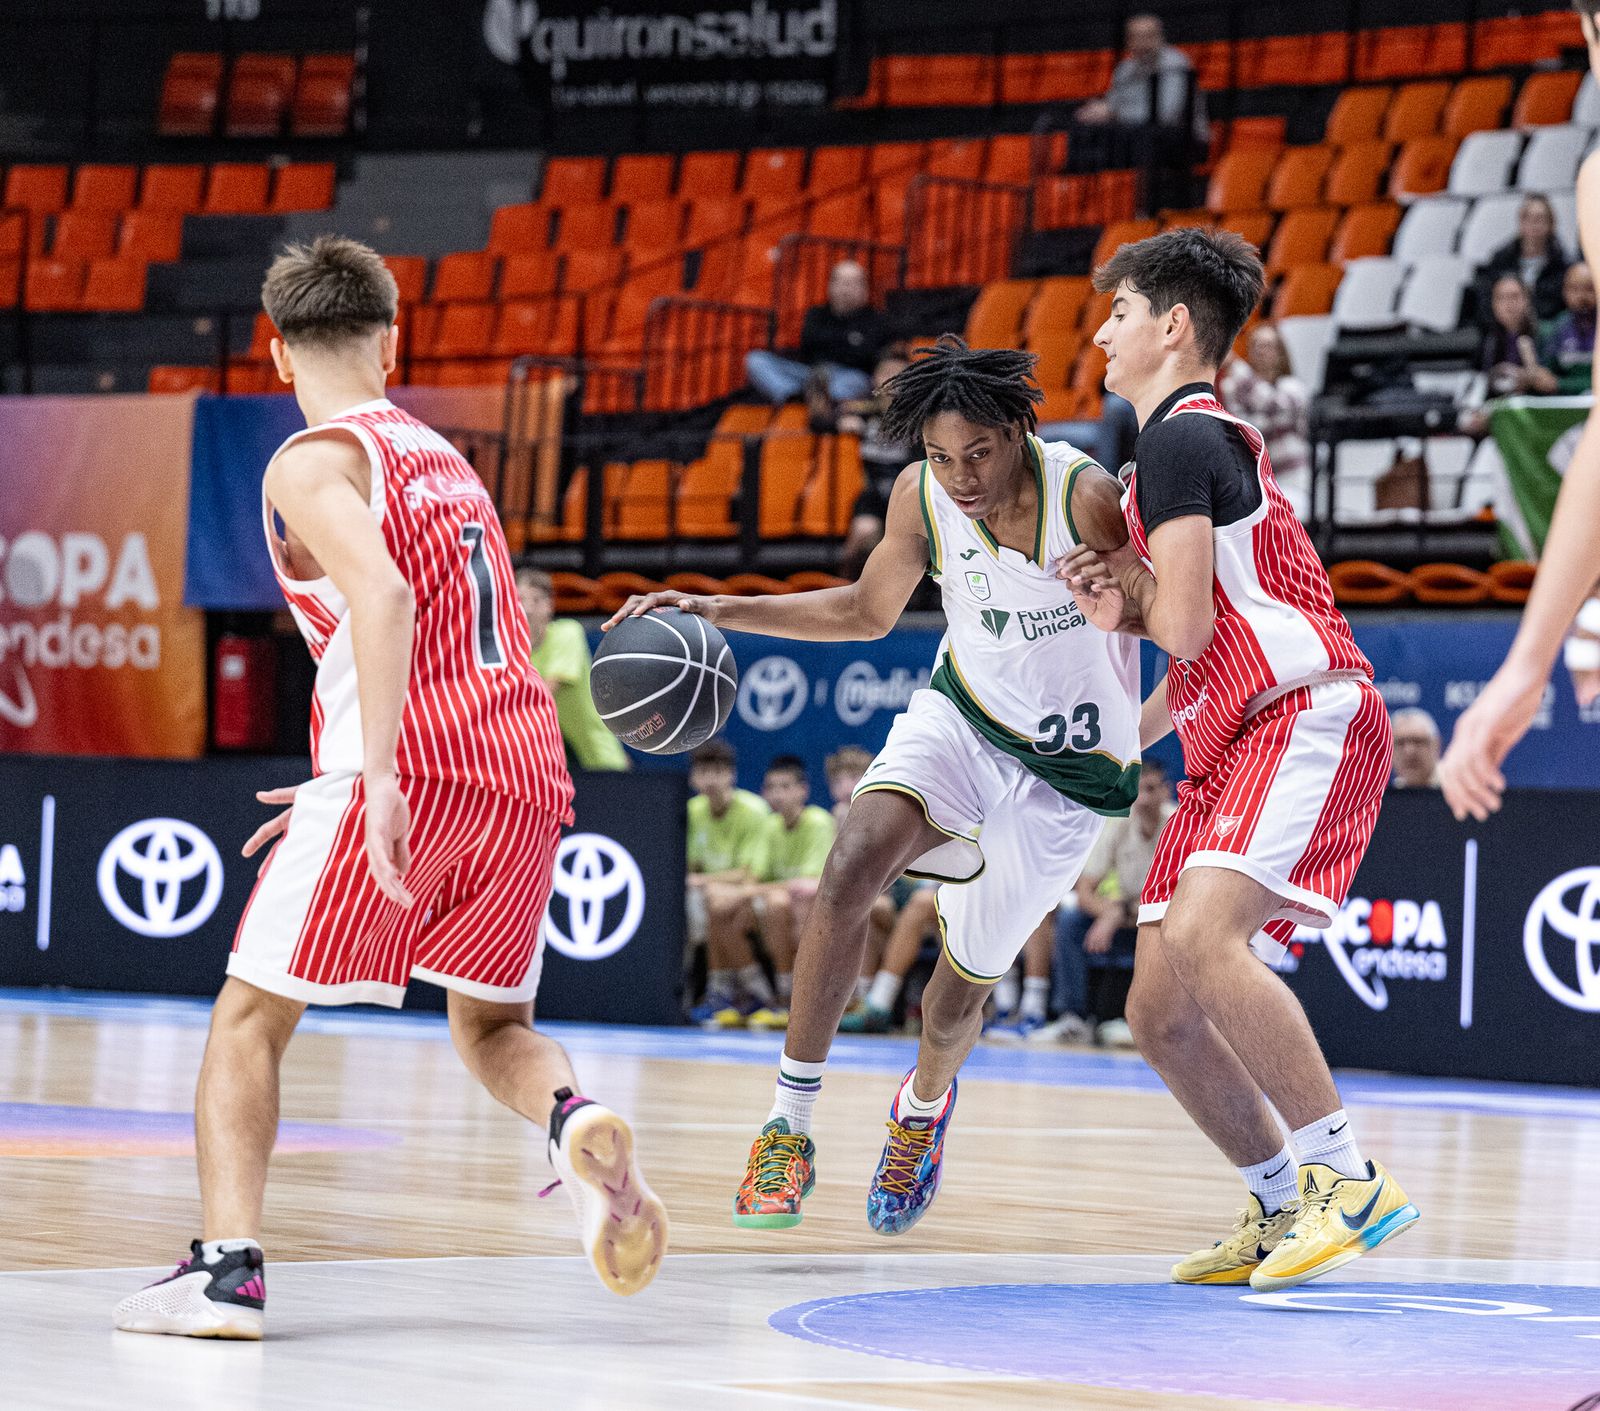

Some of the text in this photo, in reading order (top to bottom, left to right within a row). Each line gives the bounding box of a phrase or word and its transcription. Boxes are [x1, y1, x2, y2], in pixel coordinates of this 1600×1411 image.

[0, 531, 160, 611] OPA
[460, 521, 508, 669] 1
[1016, 600, 1078, 625] Funda
[1021, 611, 1087, 641] Unicaj
[1033, 702, 1101, 755] 33
